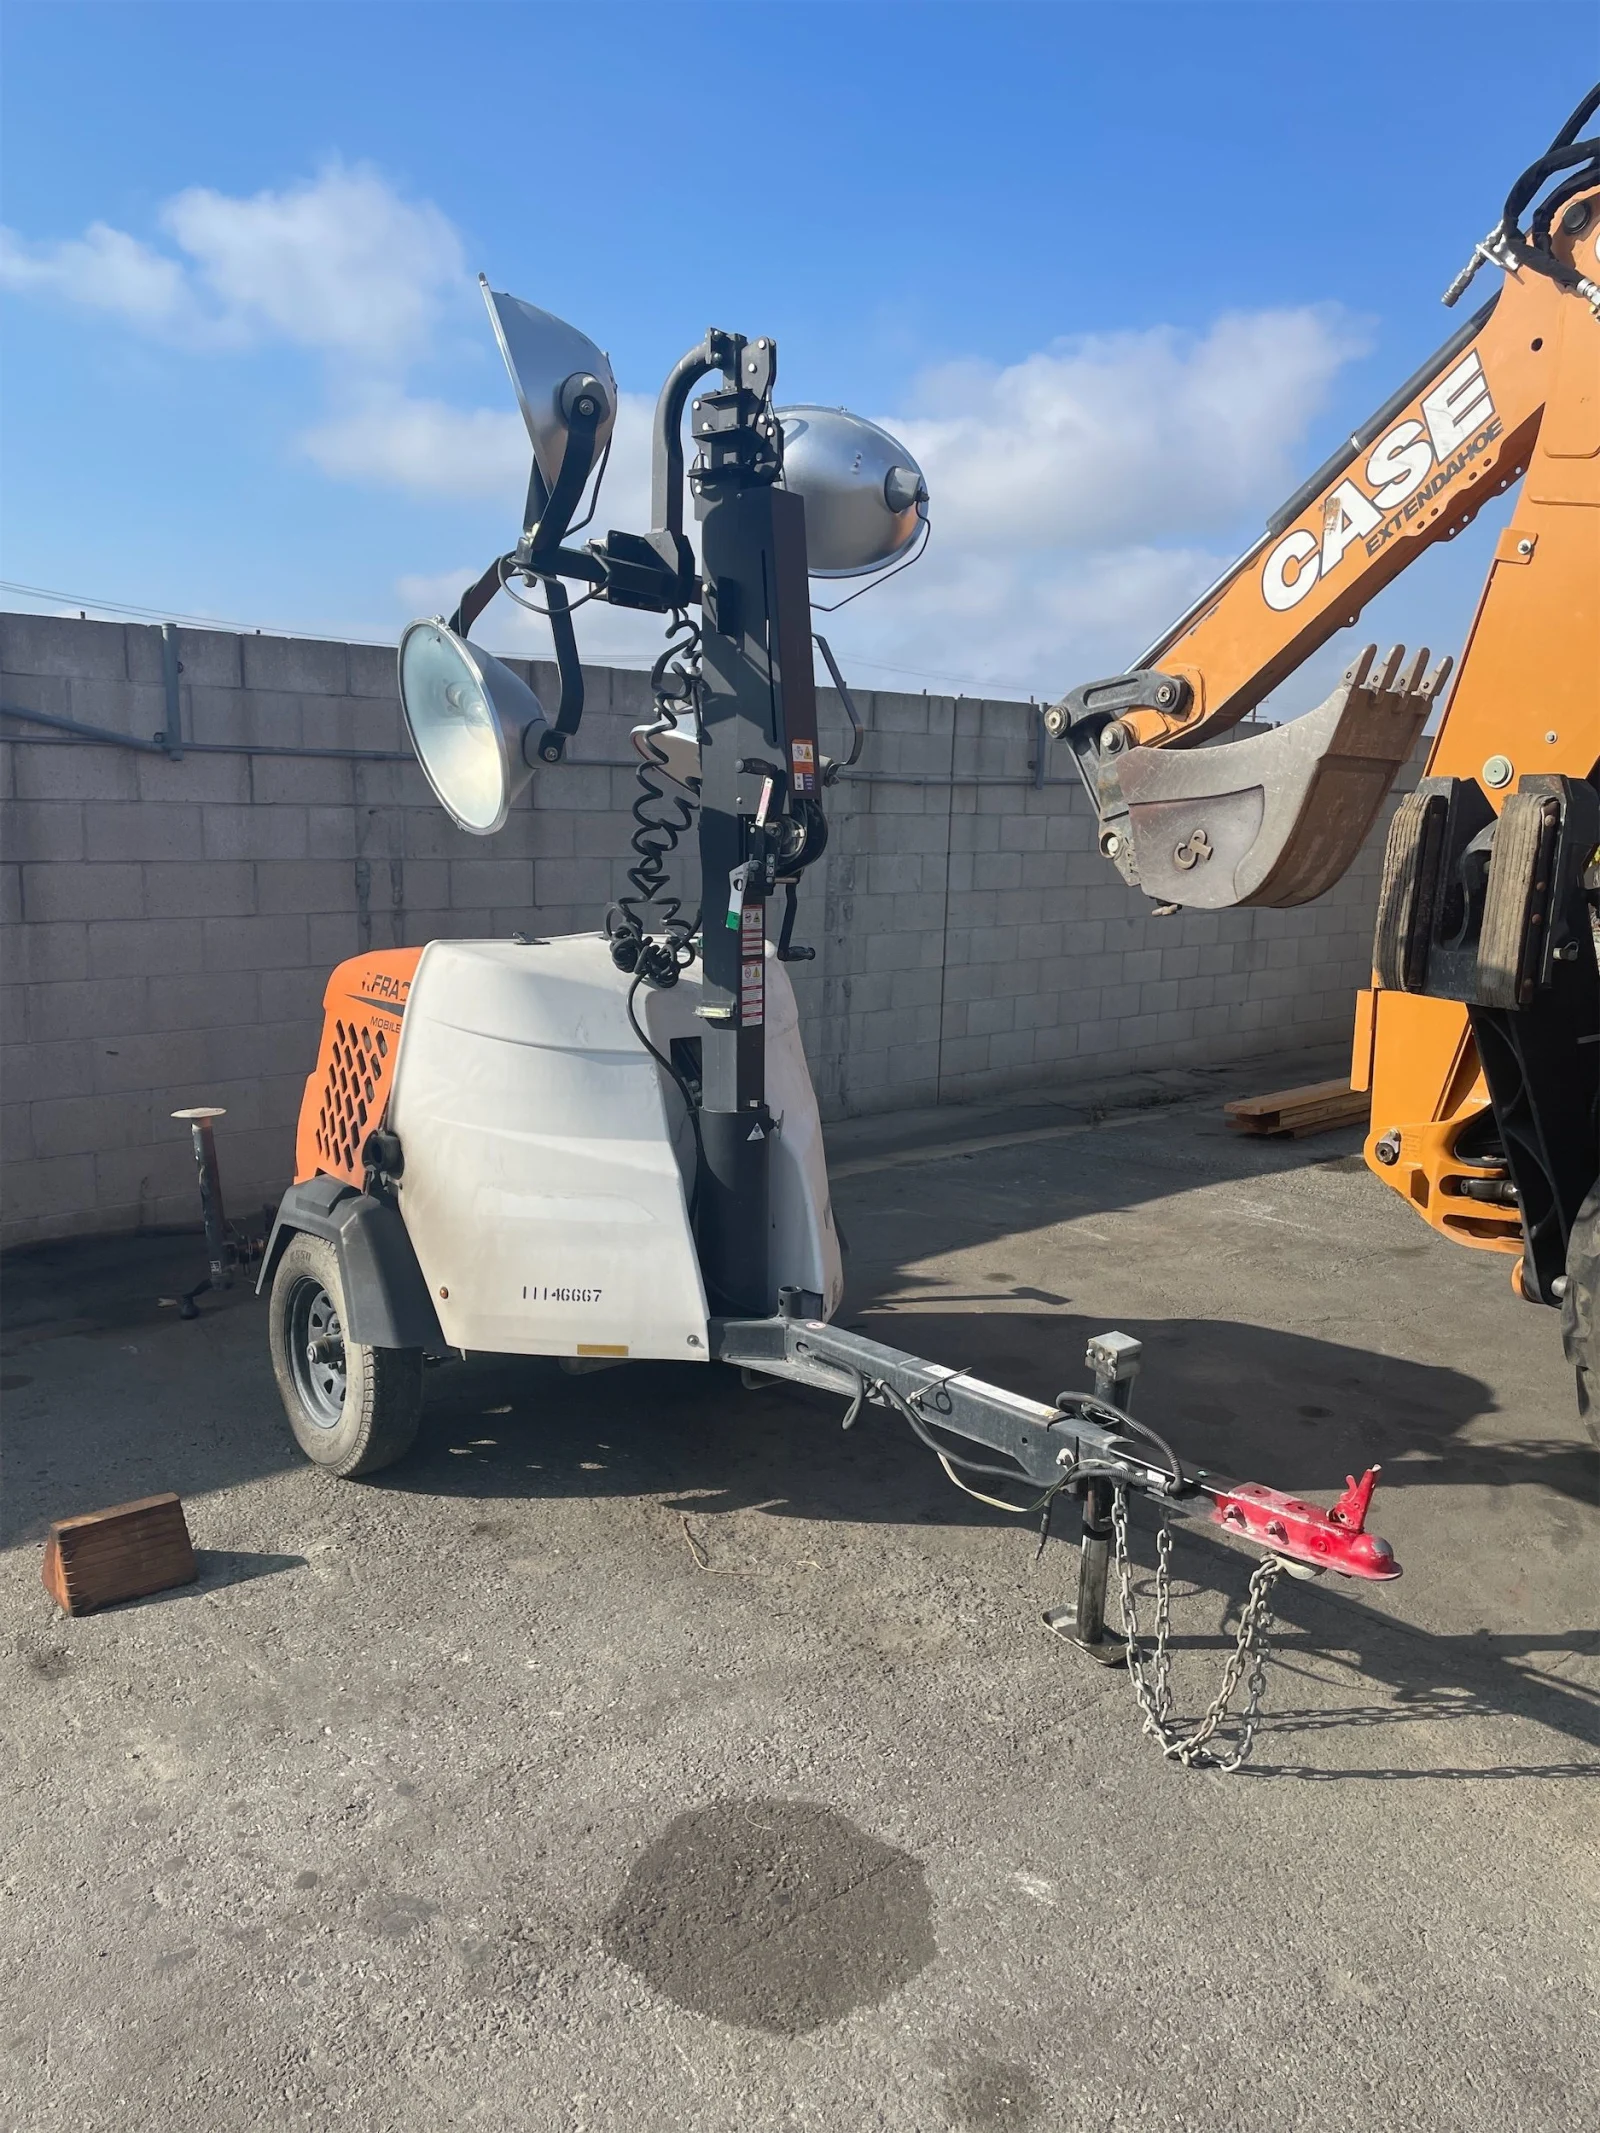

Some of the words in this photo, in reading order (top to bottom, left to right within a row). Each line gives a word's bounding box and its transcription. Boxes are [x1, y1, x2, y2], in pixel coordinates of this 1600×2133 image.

[1261, 347, 1496, 612] CASE
[1365, 416, 1505, 558] EXTENDAHOE
[370, 1016, 402, 1034] MOBILE
[523, 1286, 602, 1302] 11146667
